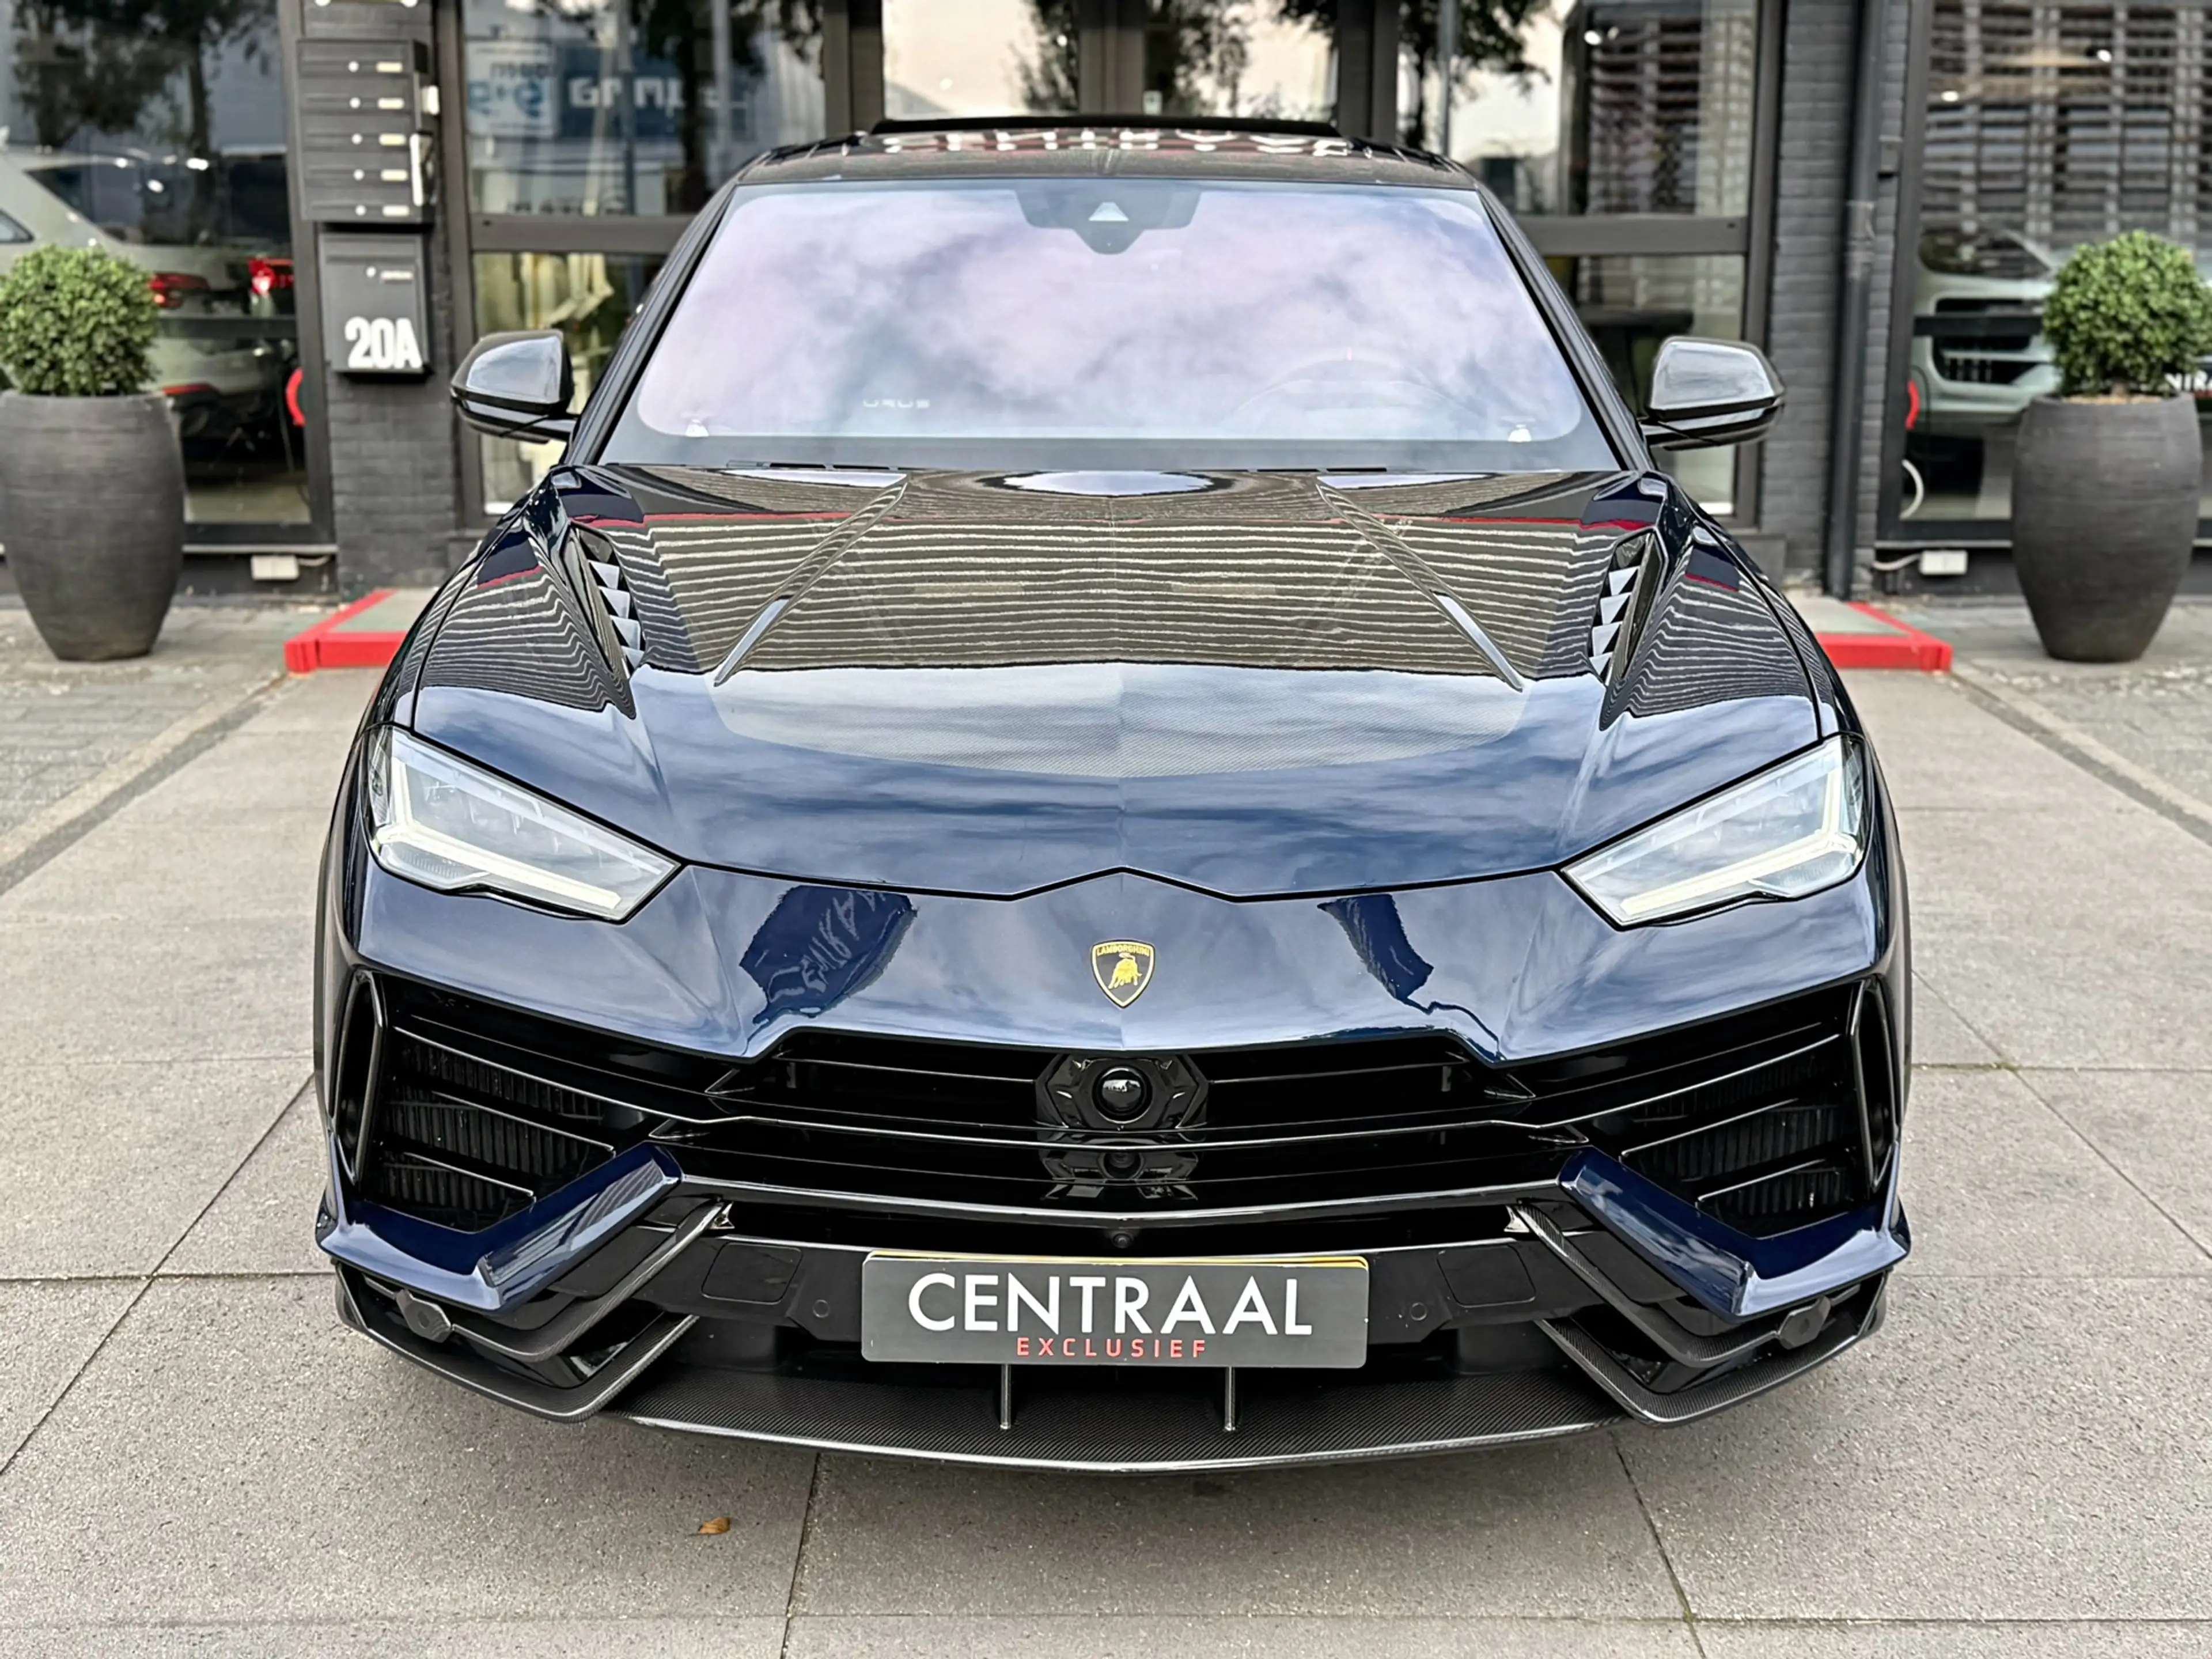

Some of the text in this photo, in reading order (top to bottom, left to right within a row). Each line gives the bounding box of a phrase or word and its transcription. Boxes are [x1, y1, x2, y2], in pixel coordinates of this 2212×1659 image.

[344, 316, 422, 369] 20A
[908, 1272, 1312, 1335] CENTRAAL
[1017, 1337, 1206, 1358] EXCLUSIEF
